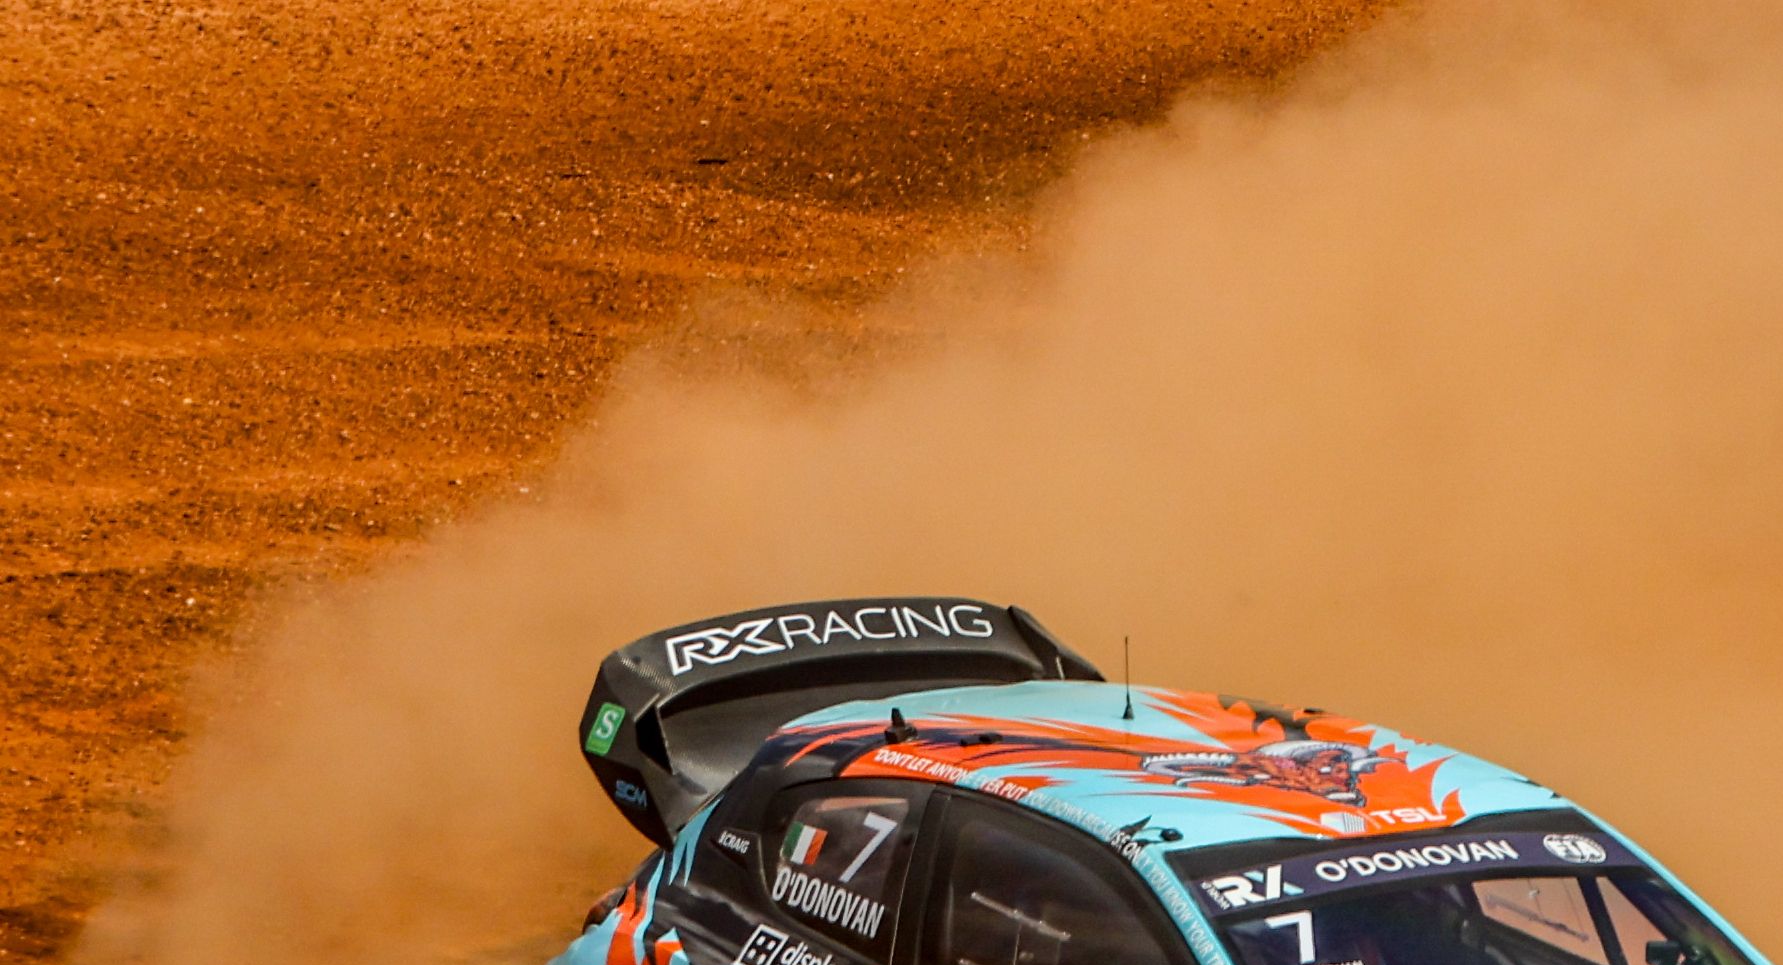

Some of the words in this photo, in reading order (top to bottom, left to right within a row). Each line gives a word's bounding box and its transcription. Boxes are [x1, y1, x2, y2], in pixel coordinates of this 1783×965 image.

[777, 603, 994, 651] RACING
[1000, 781, 1030, 803] PUT
[1369, 806, 1448, 826] TSL
[838, 811, 899, 884] 7
[1314, 838, 1520, 884] O'DONOVAN
[1545, 836, 1604, 862] FIA
[771, 866, 886, 939] O'DONOVAN
[1264, 910, 1316, 965] 7
